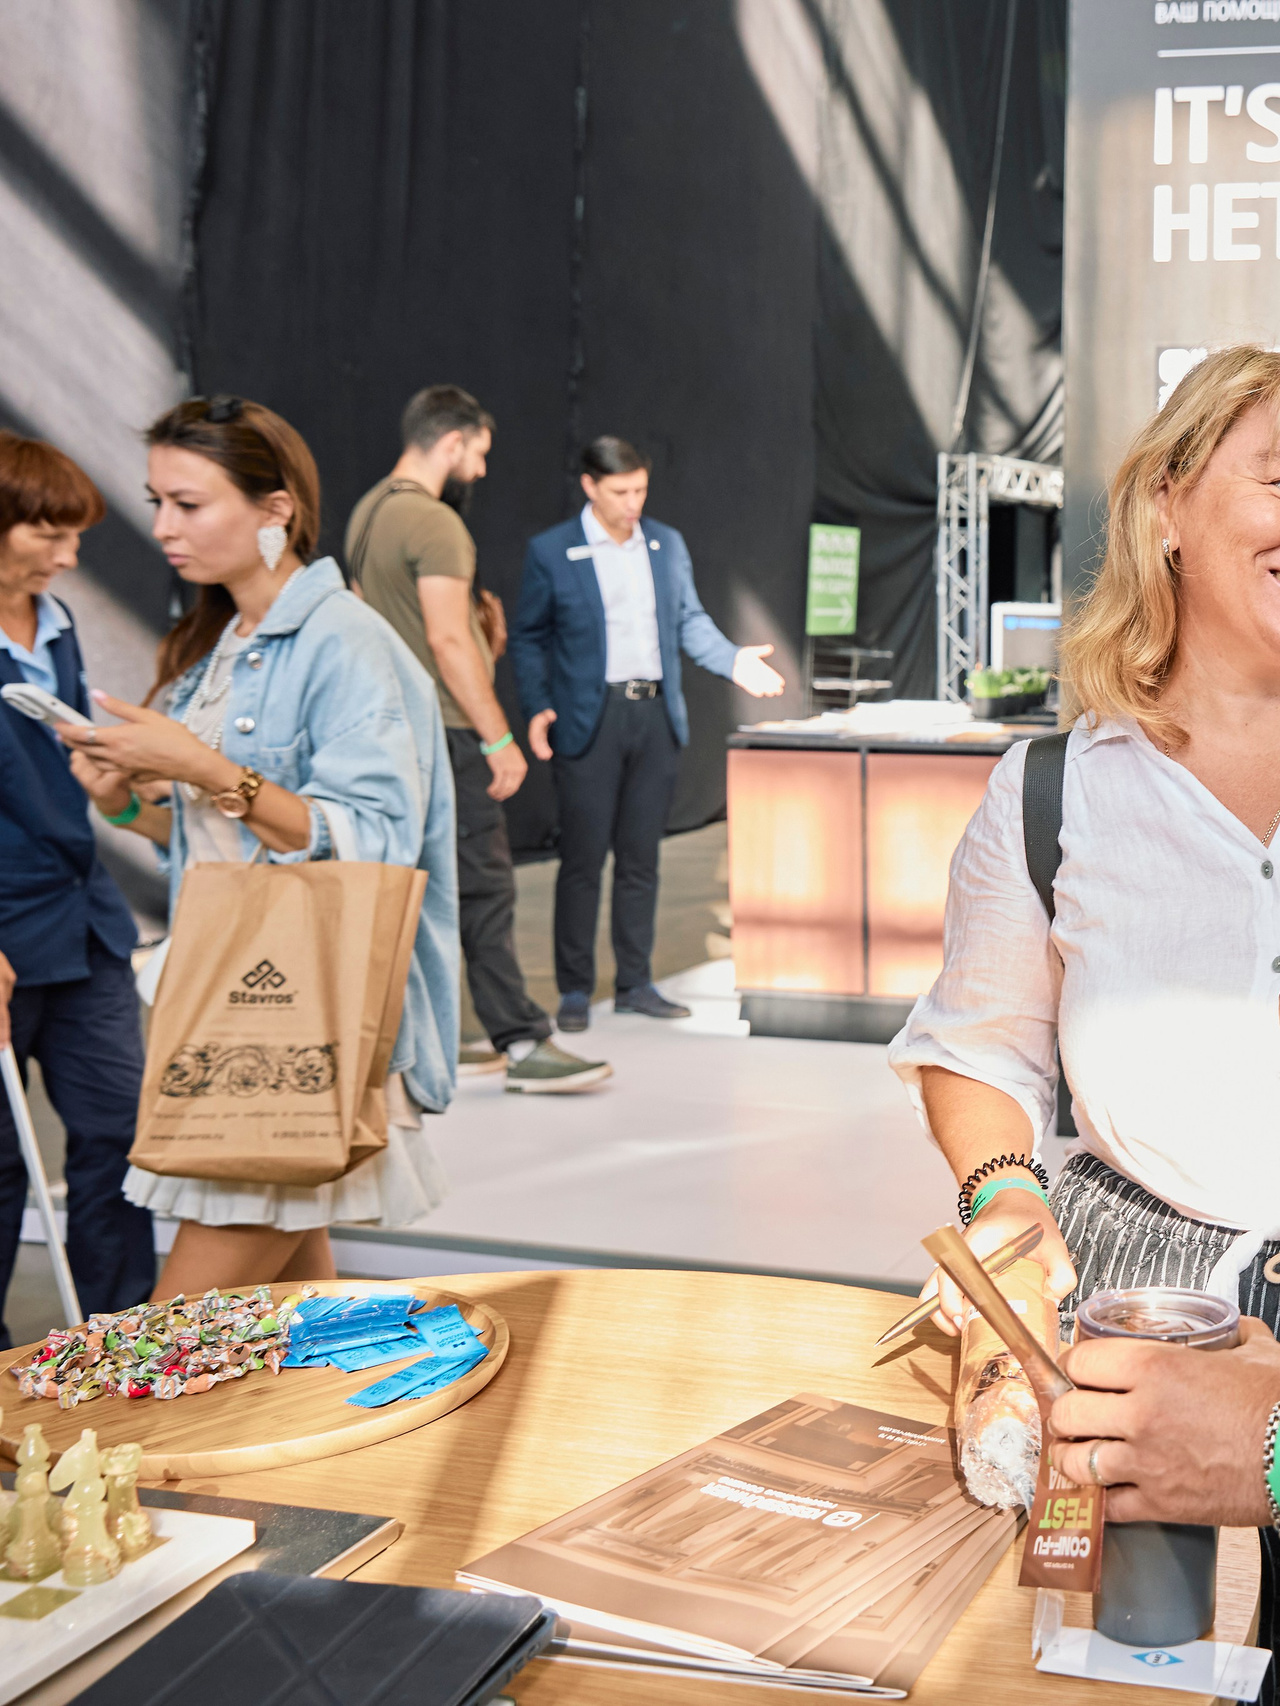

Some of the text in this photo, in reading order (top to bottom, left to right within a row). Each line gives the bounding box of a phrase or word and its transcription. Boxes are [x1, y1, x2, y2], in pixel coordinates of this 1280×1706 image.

[1155, 2, 1199, 24] ВАШ
[229, 990, 293, 1004] Stavros
[1038, 1496, 1094, 1530] FEST
[1033, 1535, 1092, 1559] CONF-FU
